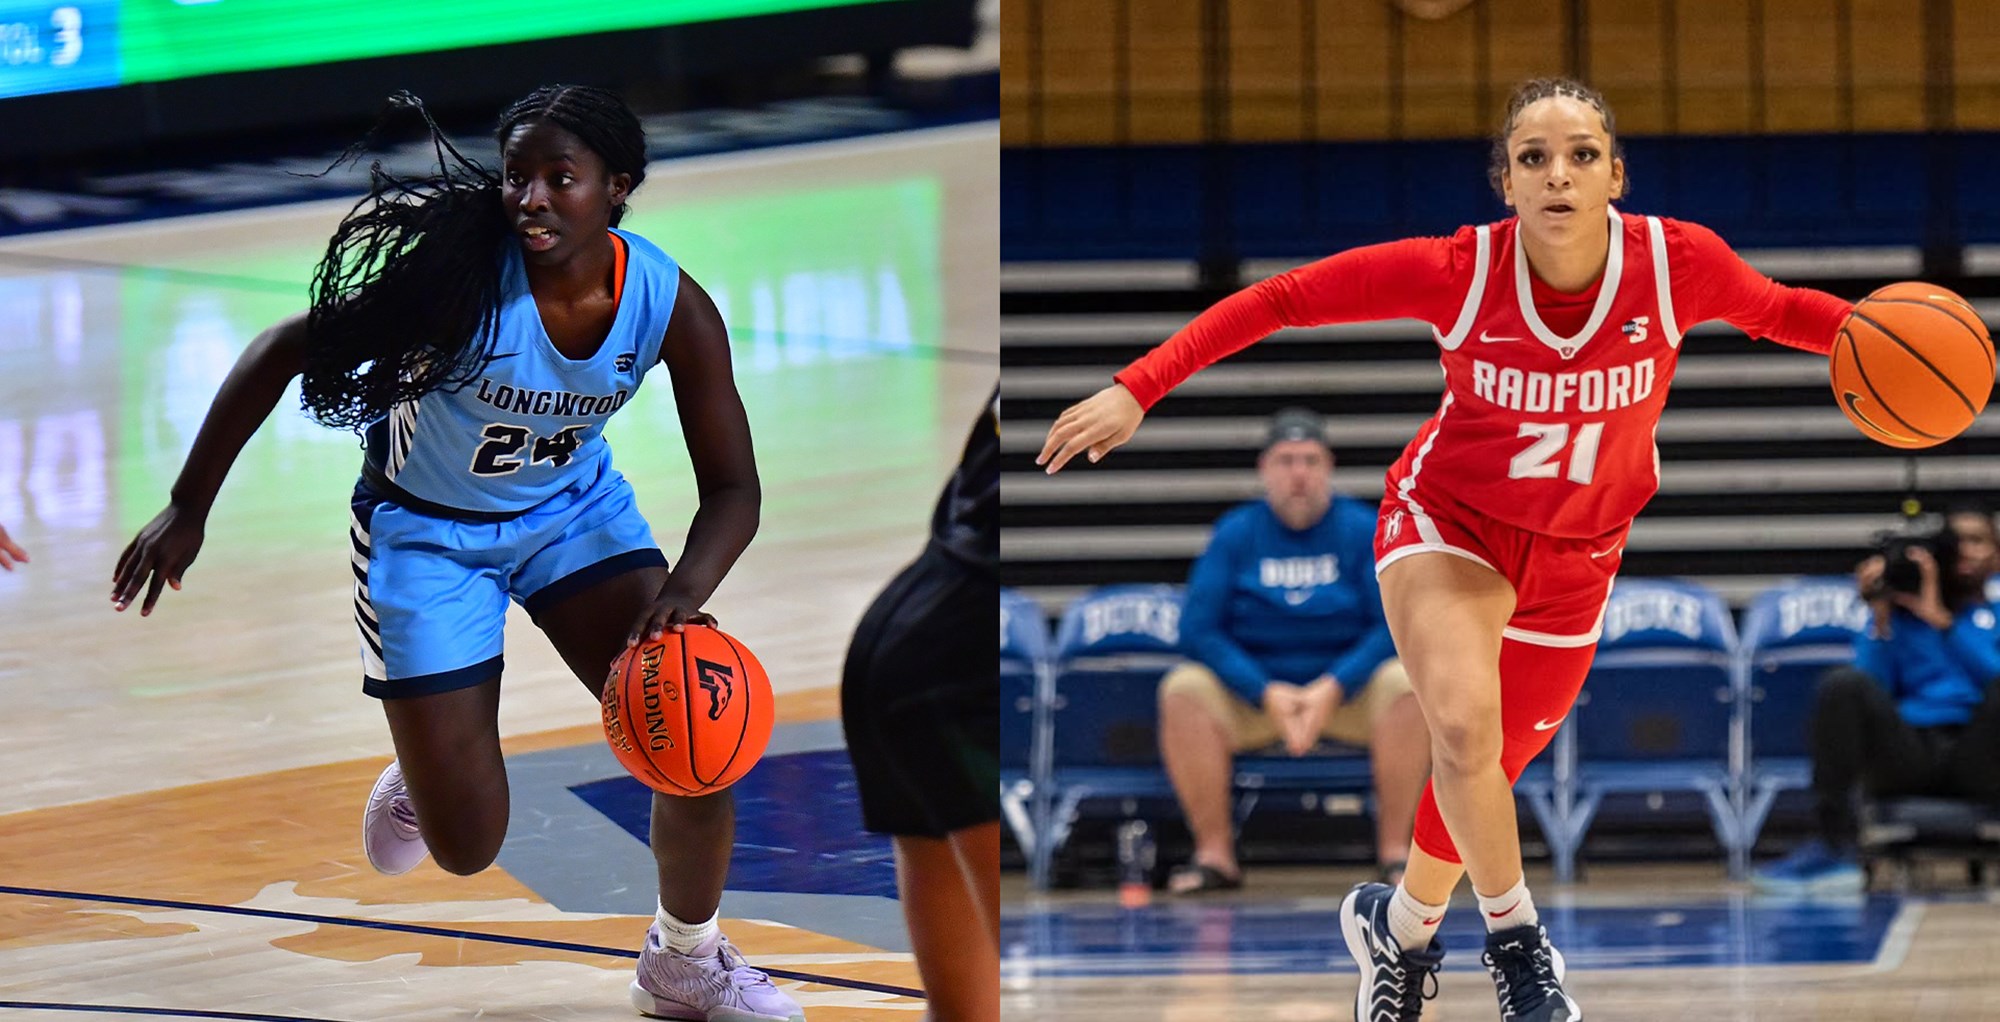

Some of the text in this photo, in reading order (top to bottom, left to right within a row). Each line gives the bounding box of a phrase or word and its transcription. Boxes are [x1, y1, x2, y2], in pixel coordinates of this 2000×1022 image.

[51, 7, 83, 66] 3
[476, 378, 629, 417] LONGWOOD
[1472, 357, 1656, 413] RADFORD
[469, 422, 593, 478] 24
[1507, 421, 1606, 486] 21
[642, 643, 676, 752] SPALDING
